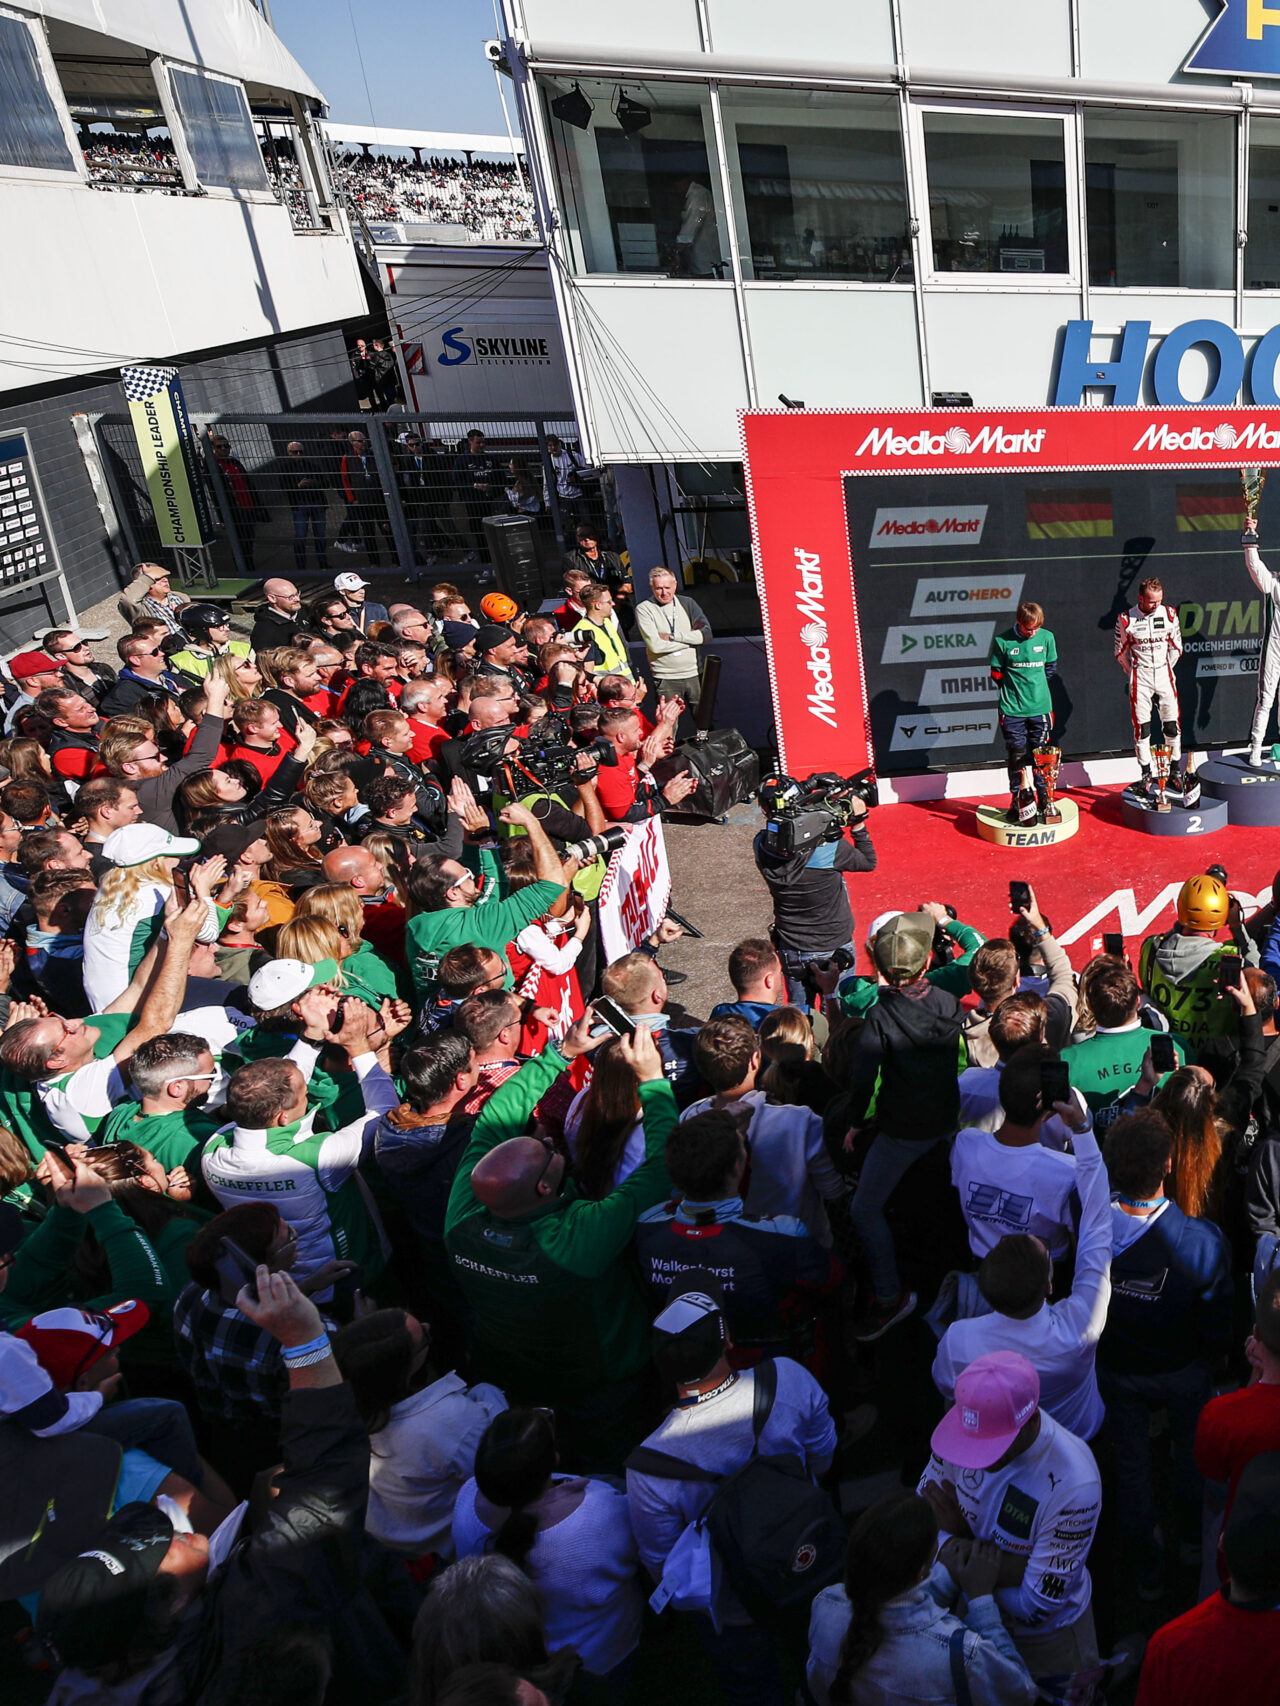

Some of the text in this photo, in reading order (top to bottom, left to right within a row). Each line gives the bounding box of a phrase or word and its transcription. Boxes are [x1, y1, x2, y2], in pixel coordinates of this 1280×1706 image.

[476, 338, 549, 356] SKYLINE
[144, 401, 186, 543] CHAMPIONSHIP LEADER
[925, 587, 1012, 603] AUTOHERO
[1180, 600, 1260, 637] DTM
[924, 633, 977, 649] DEKRA
[1183, 639, 1263, 653] OCKENHEIMRIN
[941, 676, 999, 694] MAHL
[924, 722, 991, 735] CUPRA
[1006, 831, 1055, 846] TEAM
[1153, 983, 1214, 1012] 073
[1171, 1018, 1210, 1033] EDIA
[206, 1170, 297, 1192] SCHAEFFLER
[454, 1254, 540, 1285] SCHAEFFLER
[1002, 1503, 1031, 1525] DTM
